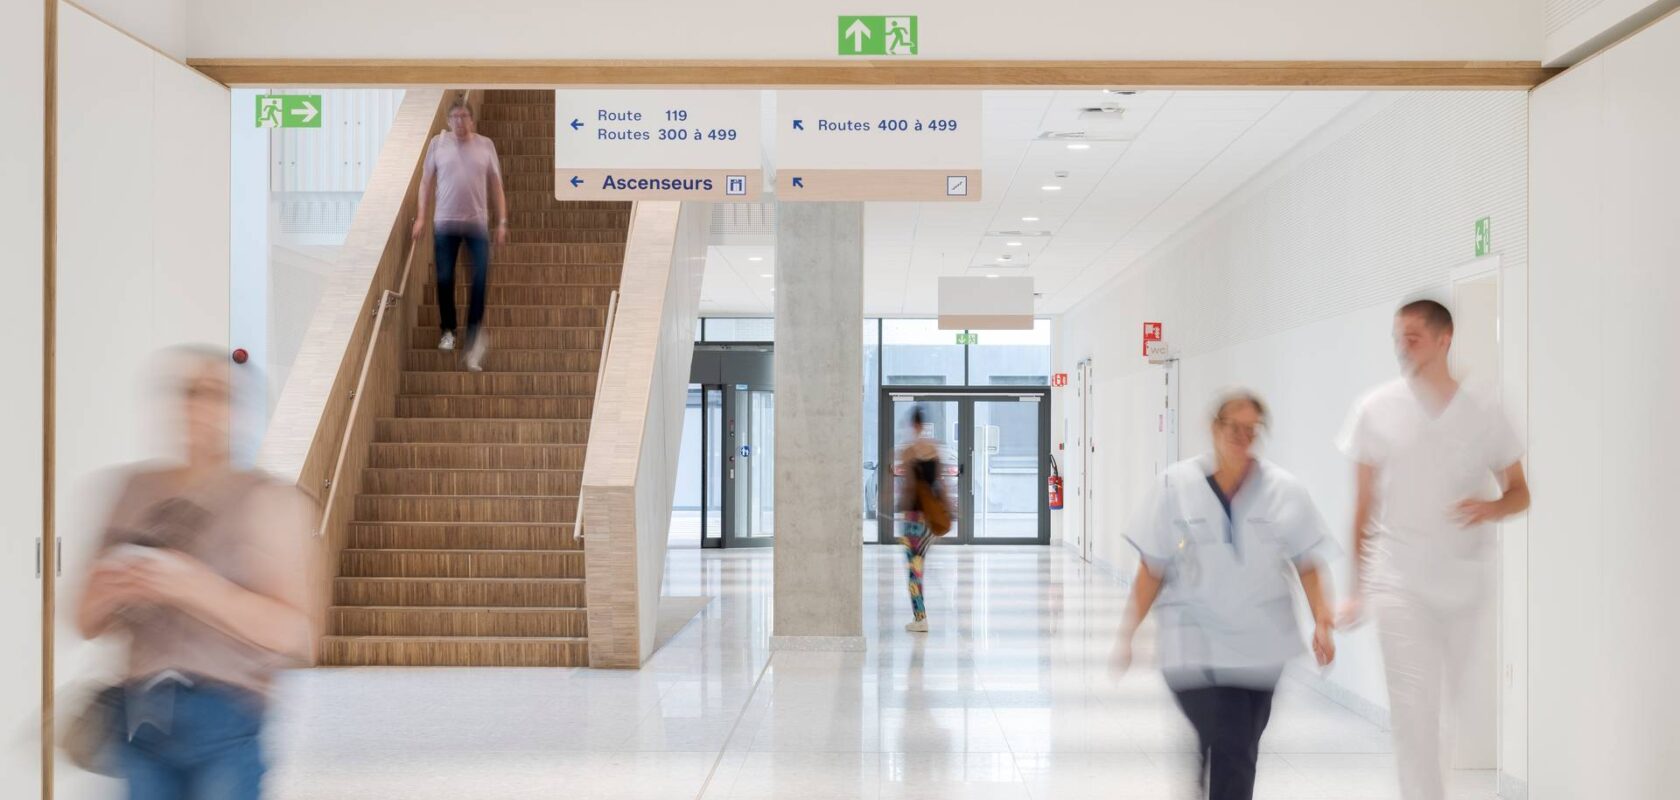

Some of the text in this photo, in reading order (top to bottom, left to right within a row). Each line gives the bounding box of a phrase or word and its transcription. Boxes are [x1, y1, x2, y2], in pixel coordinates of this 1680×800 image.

[597, 109, 688, 122] Route 119
[818, 119, 958, 132] Routes 400 à 499
[597, 128, 737, 141] Routes 300 à 499
[602, 174, 713, 191] Ascenseurs
